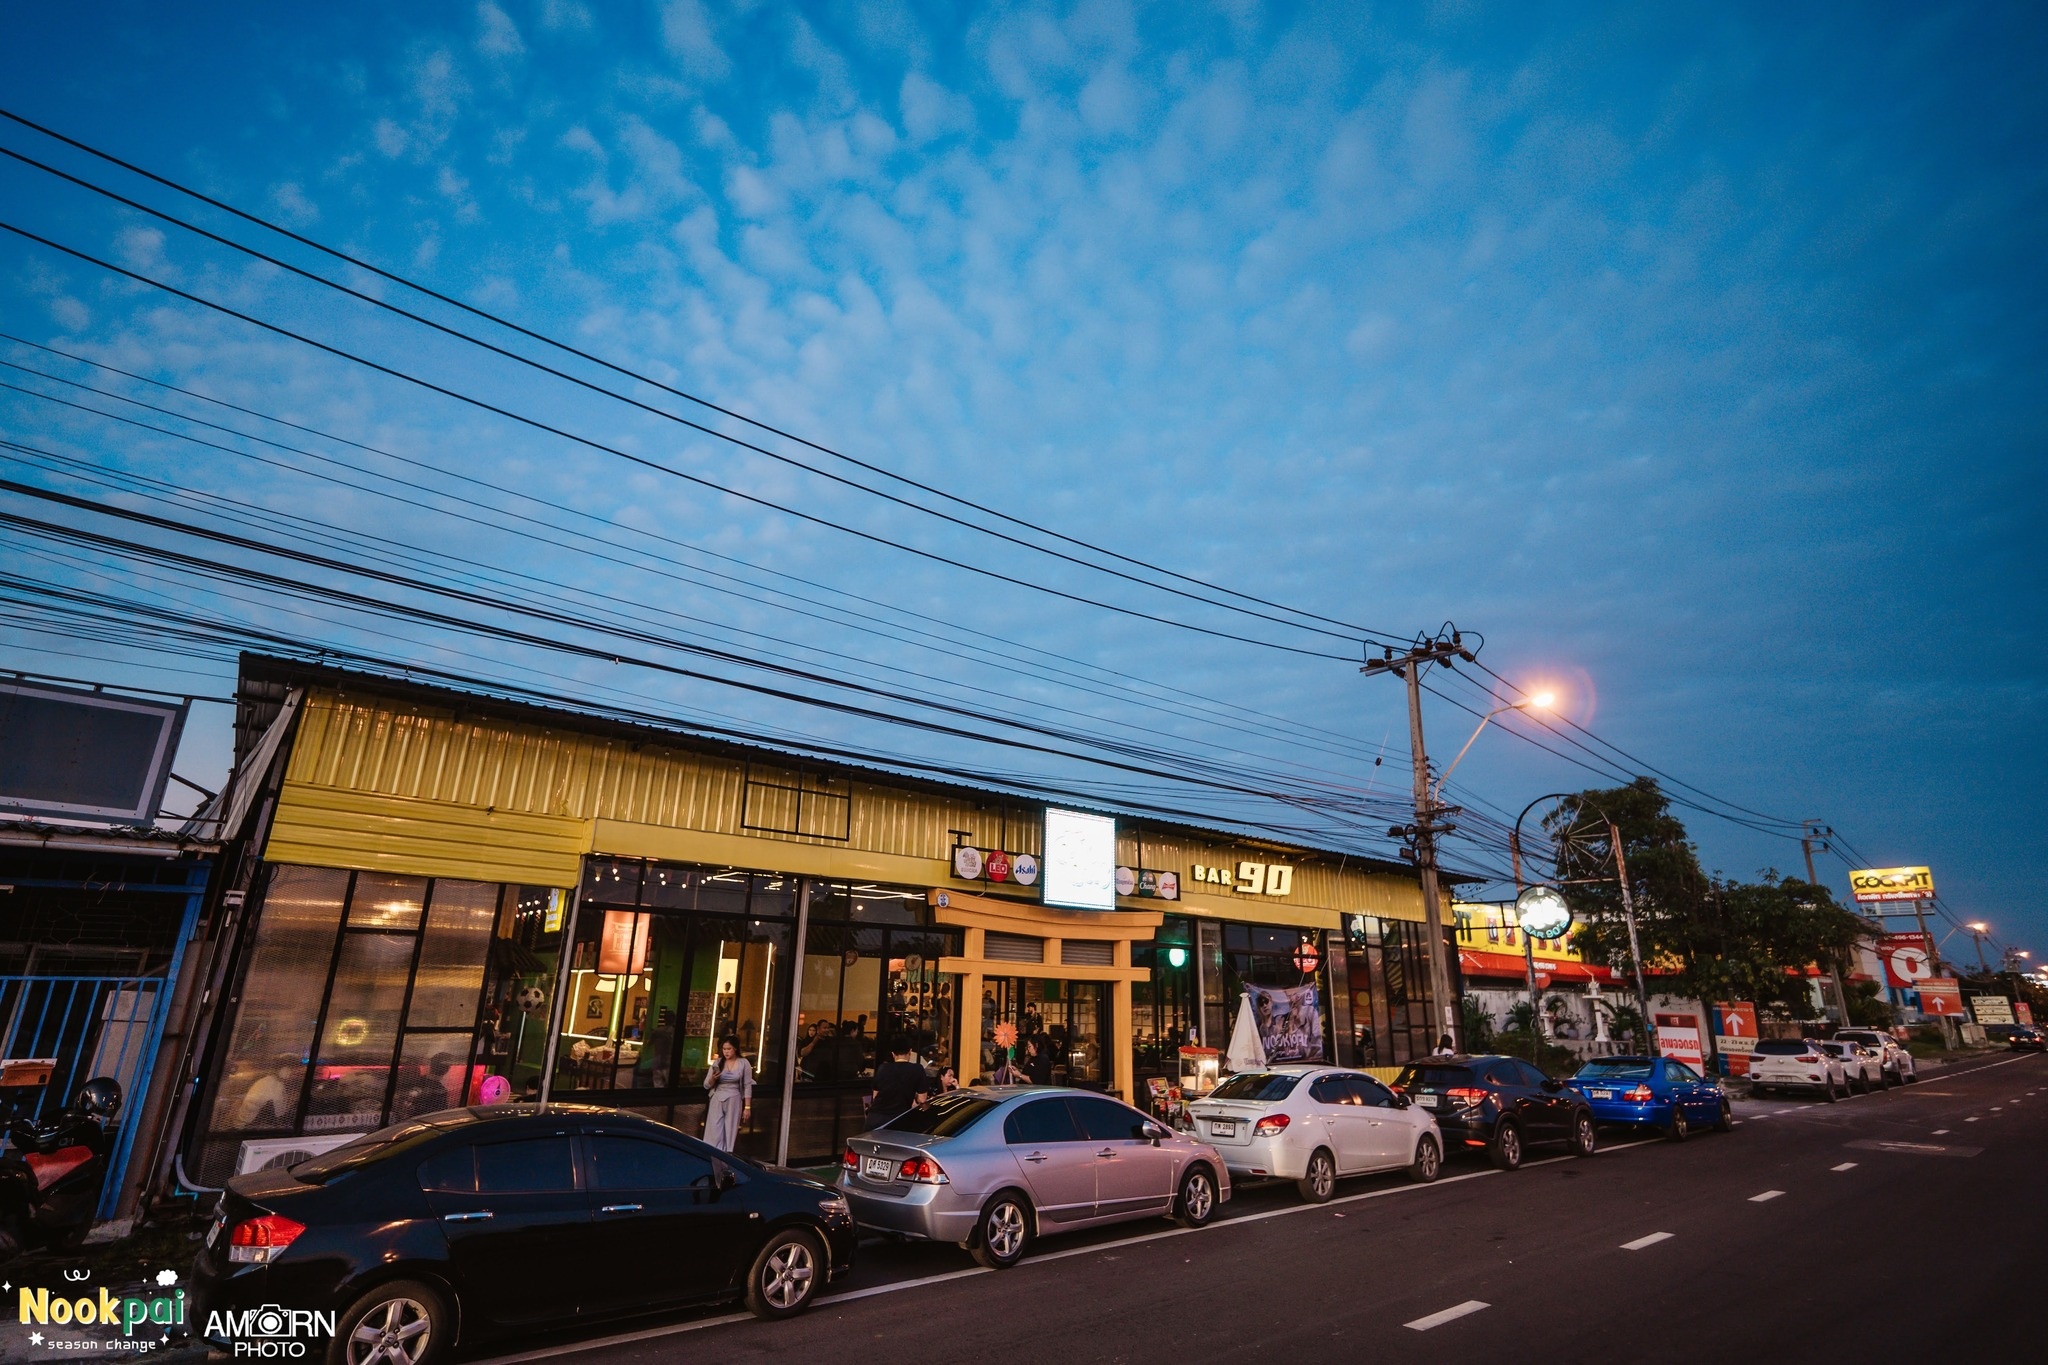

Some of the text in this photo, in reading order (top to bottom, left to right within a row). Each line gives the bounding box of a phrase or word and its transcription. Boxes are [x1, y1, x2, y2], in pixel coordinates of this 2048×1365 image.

[991, 863, 1007, 872] LEO
[1015, 864, 1036, 874] Asahi
[1194, 861, 1293, 895] BAR 90
[1140, 881, 1156, 891] Chang
[1524, 924, 1545, 939] BAR
